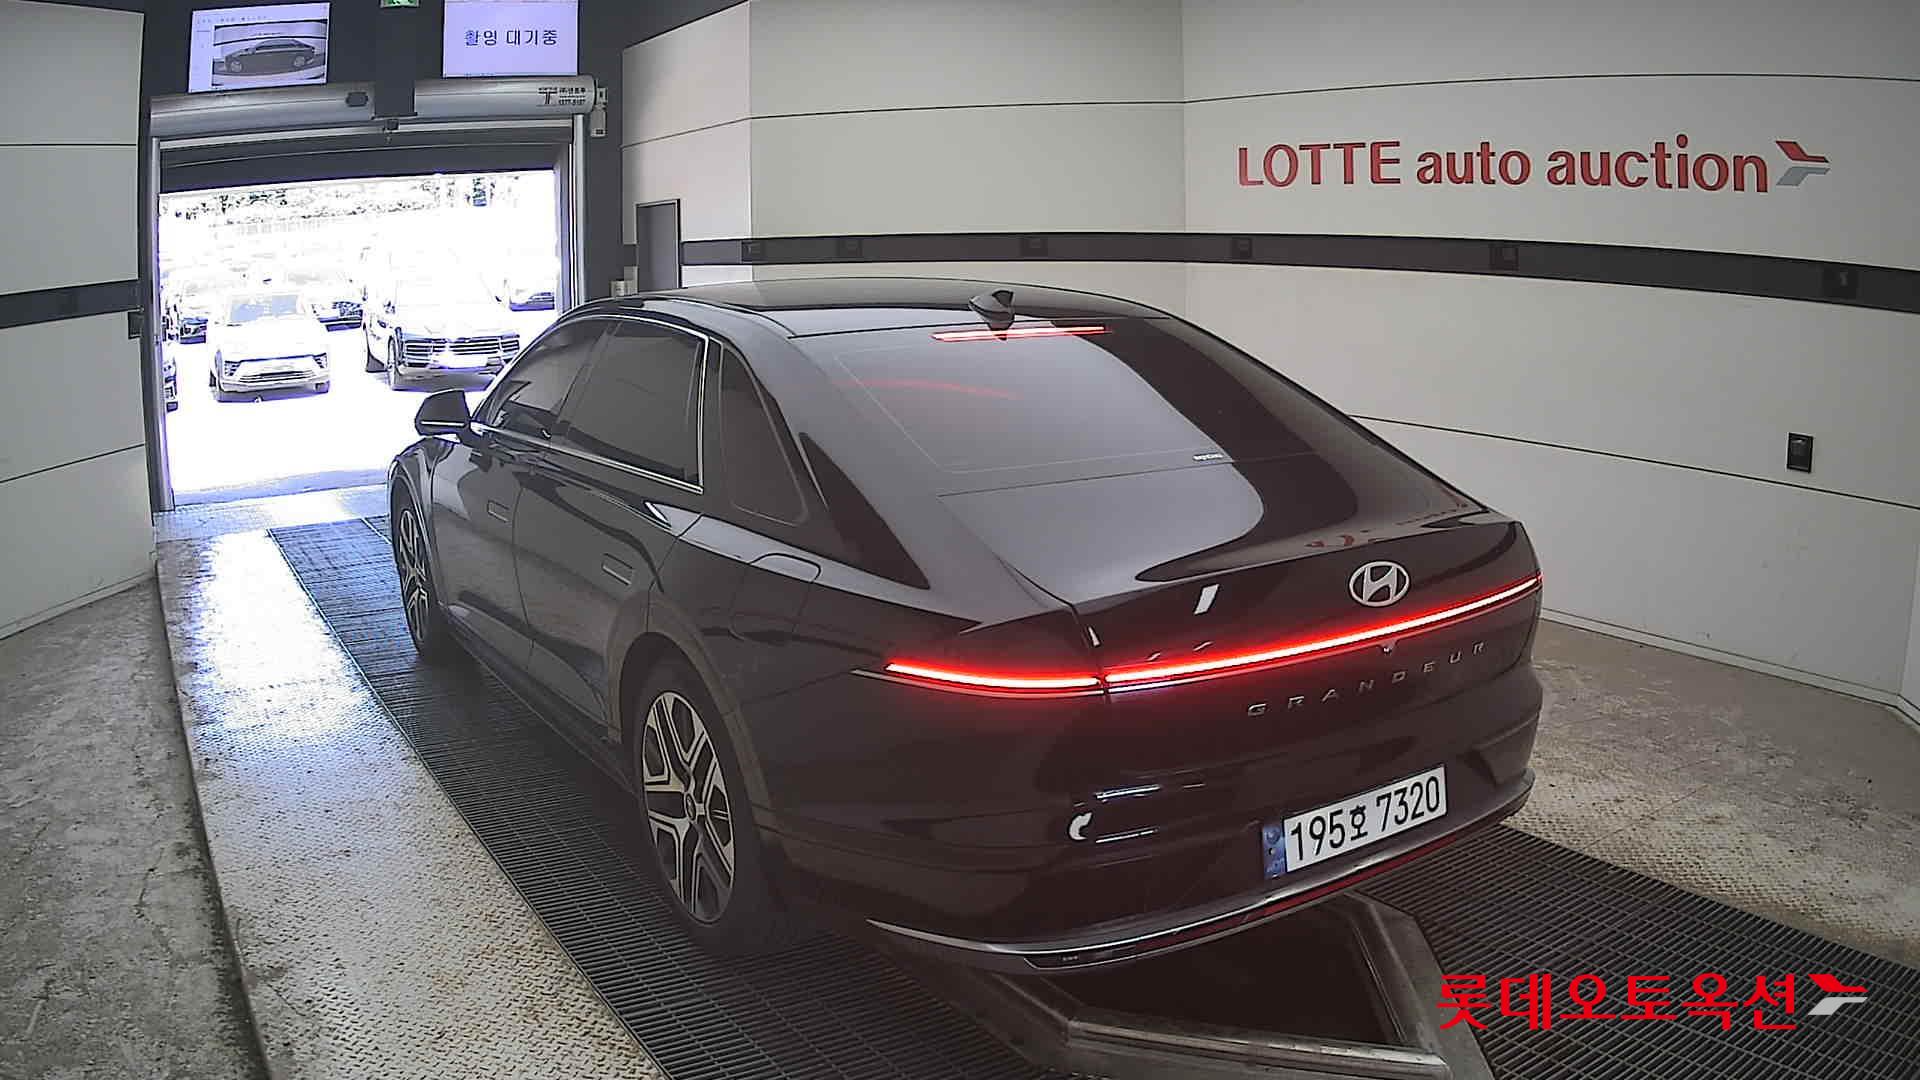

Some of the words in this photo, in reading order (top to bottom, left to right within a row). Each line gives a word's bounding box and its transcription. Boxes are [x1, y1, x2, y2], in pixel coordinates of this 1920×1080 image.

[506, 28, 558, 46] 대기중
[1237, 140, 1400, 188] LOTTE
[1416, 142, 1532, 186] auto
[1546, 133, 1769, 193] auction
[1247, 641, 1486, 717] GRANDEUR
[1290, 804, 1369, 861] 195호
[1375, 776, 1441, 832] 7320
